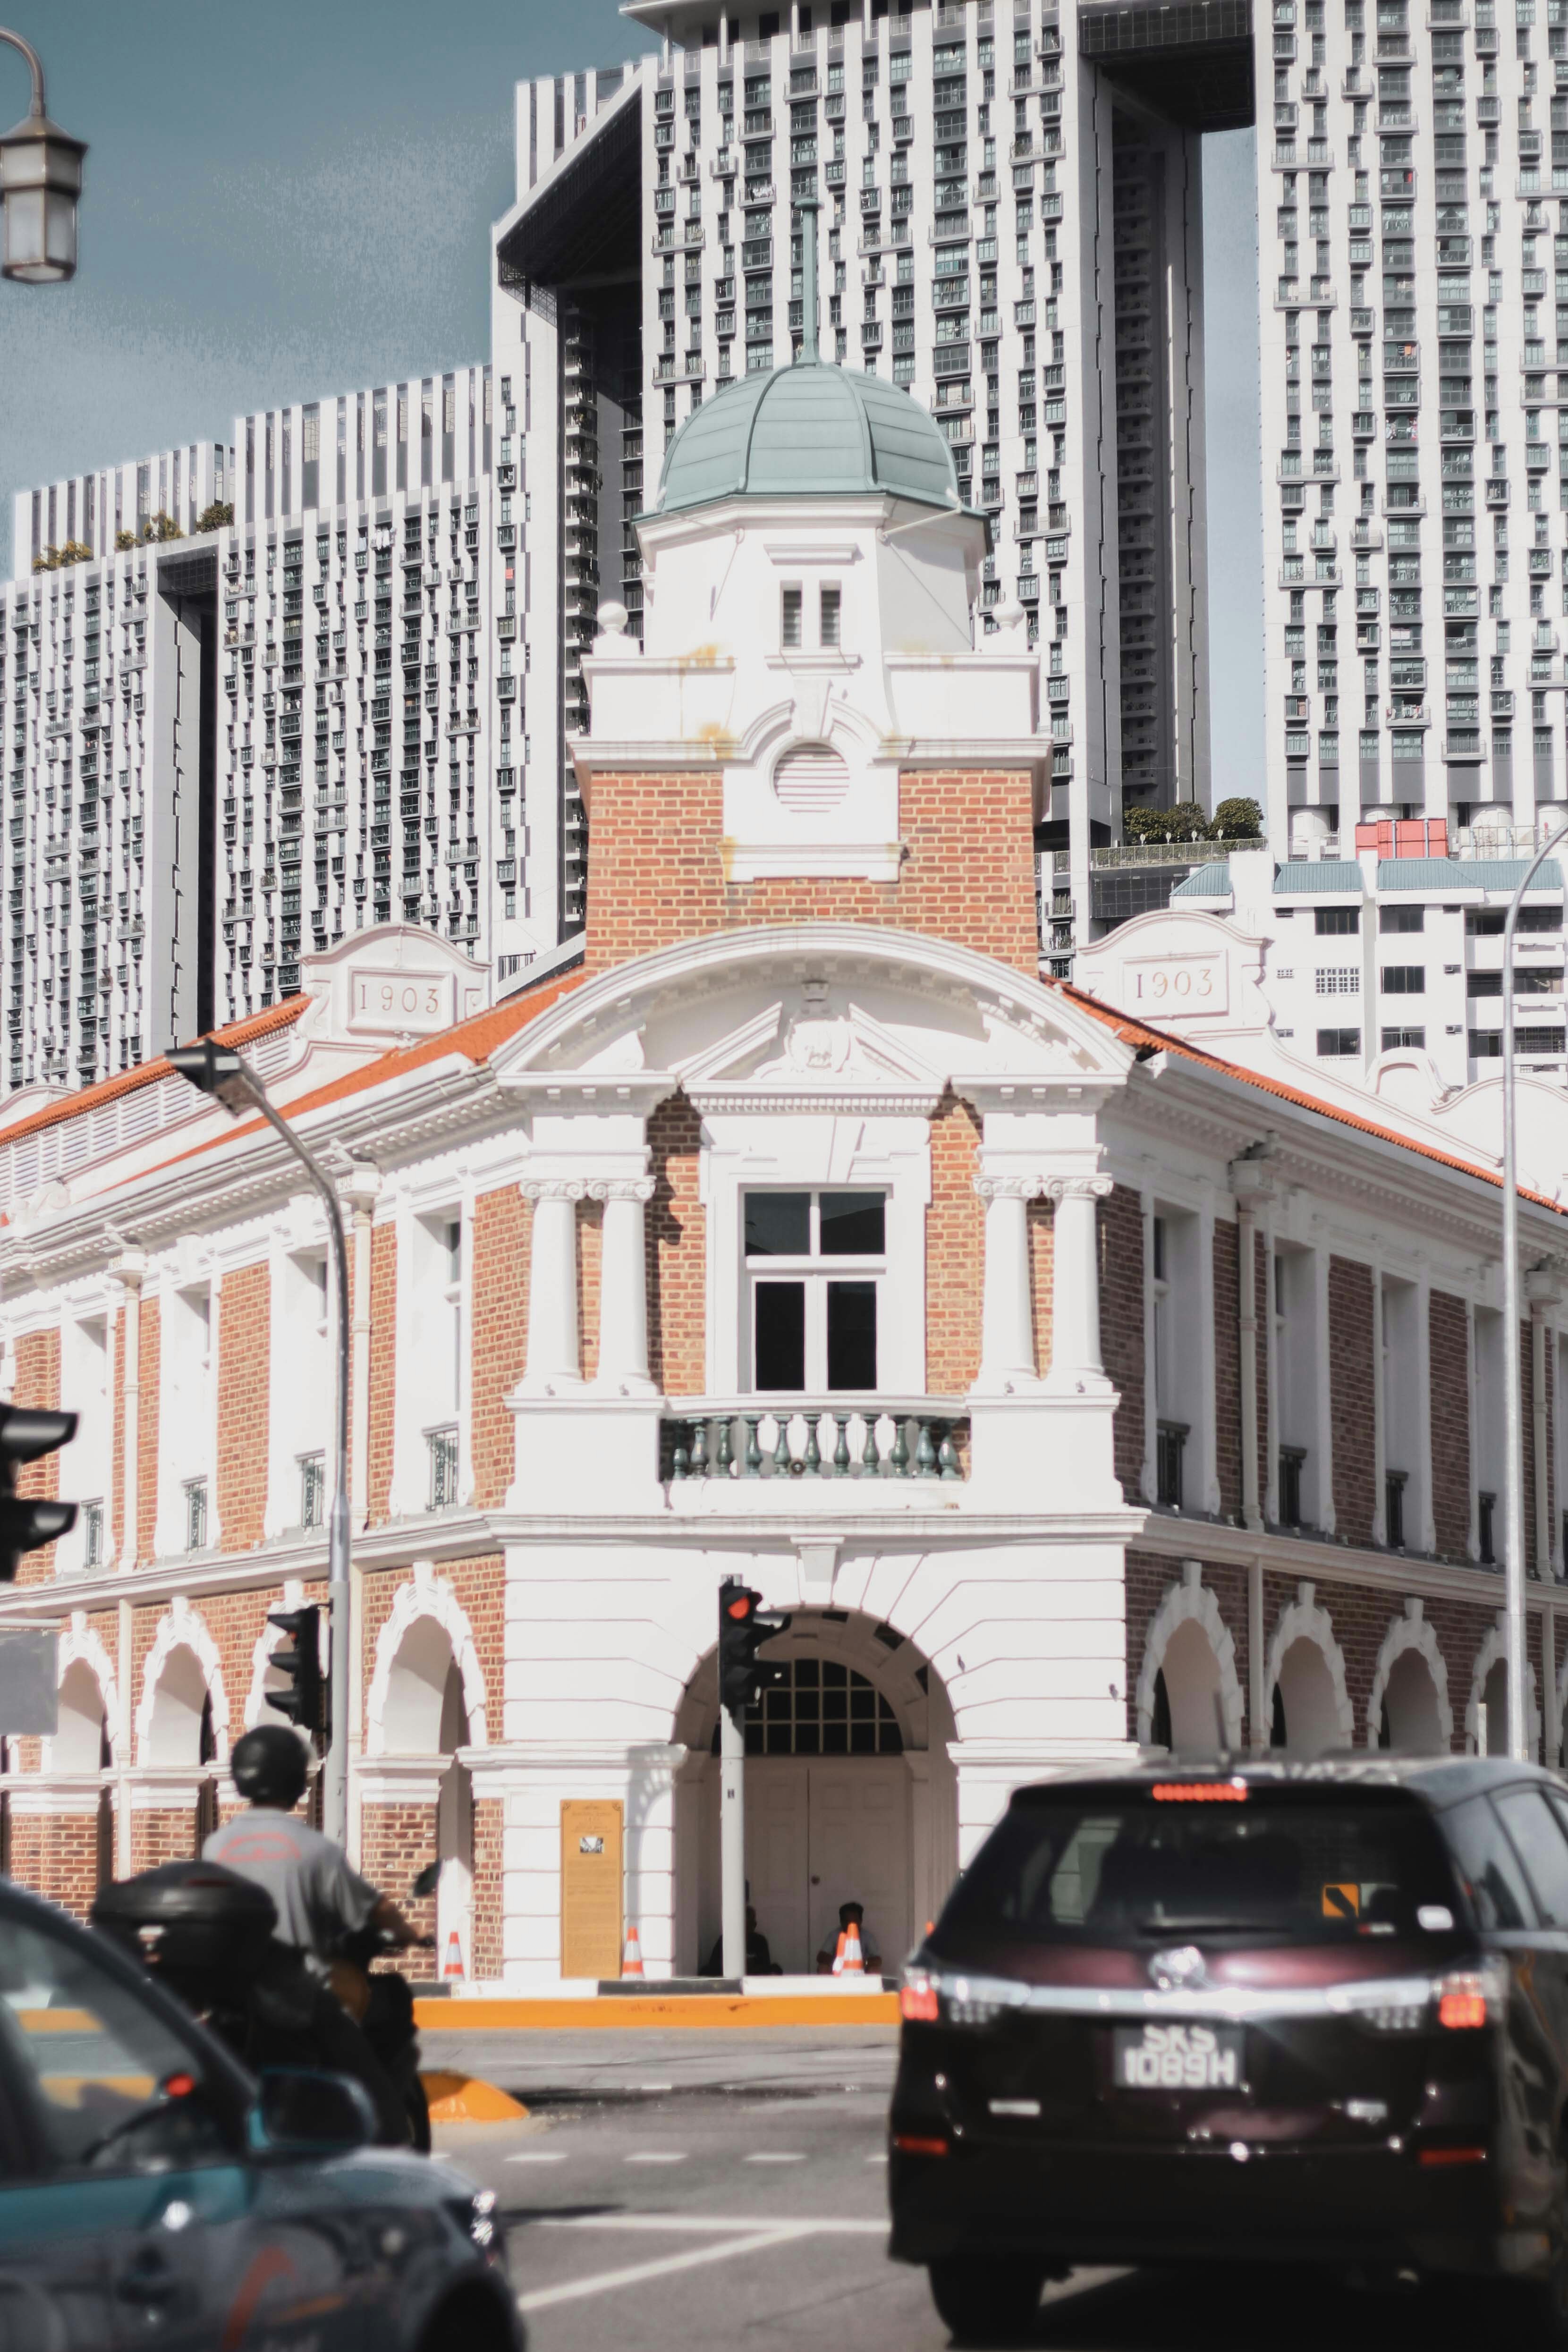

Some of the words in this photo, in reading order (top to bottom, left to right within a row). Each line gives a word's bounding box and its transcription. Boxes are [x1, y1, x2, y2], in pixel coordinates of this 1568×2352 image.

[1137, 969, 1212, 998] 1903
[360, 984, 438, 1014] 1903
[1143, 2024, 1217, 2054] SKS
[1124, 2047, 1235, 2087] 1089H
